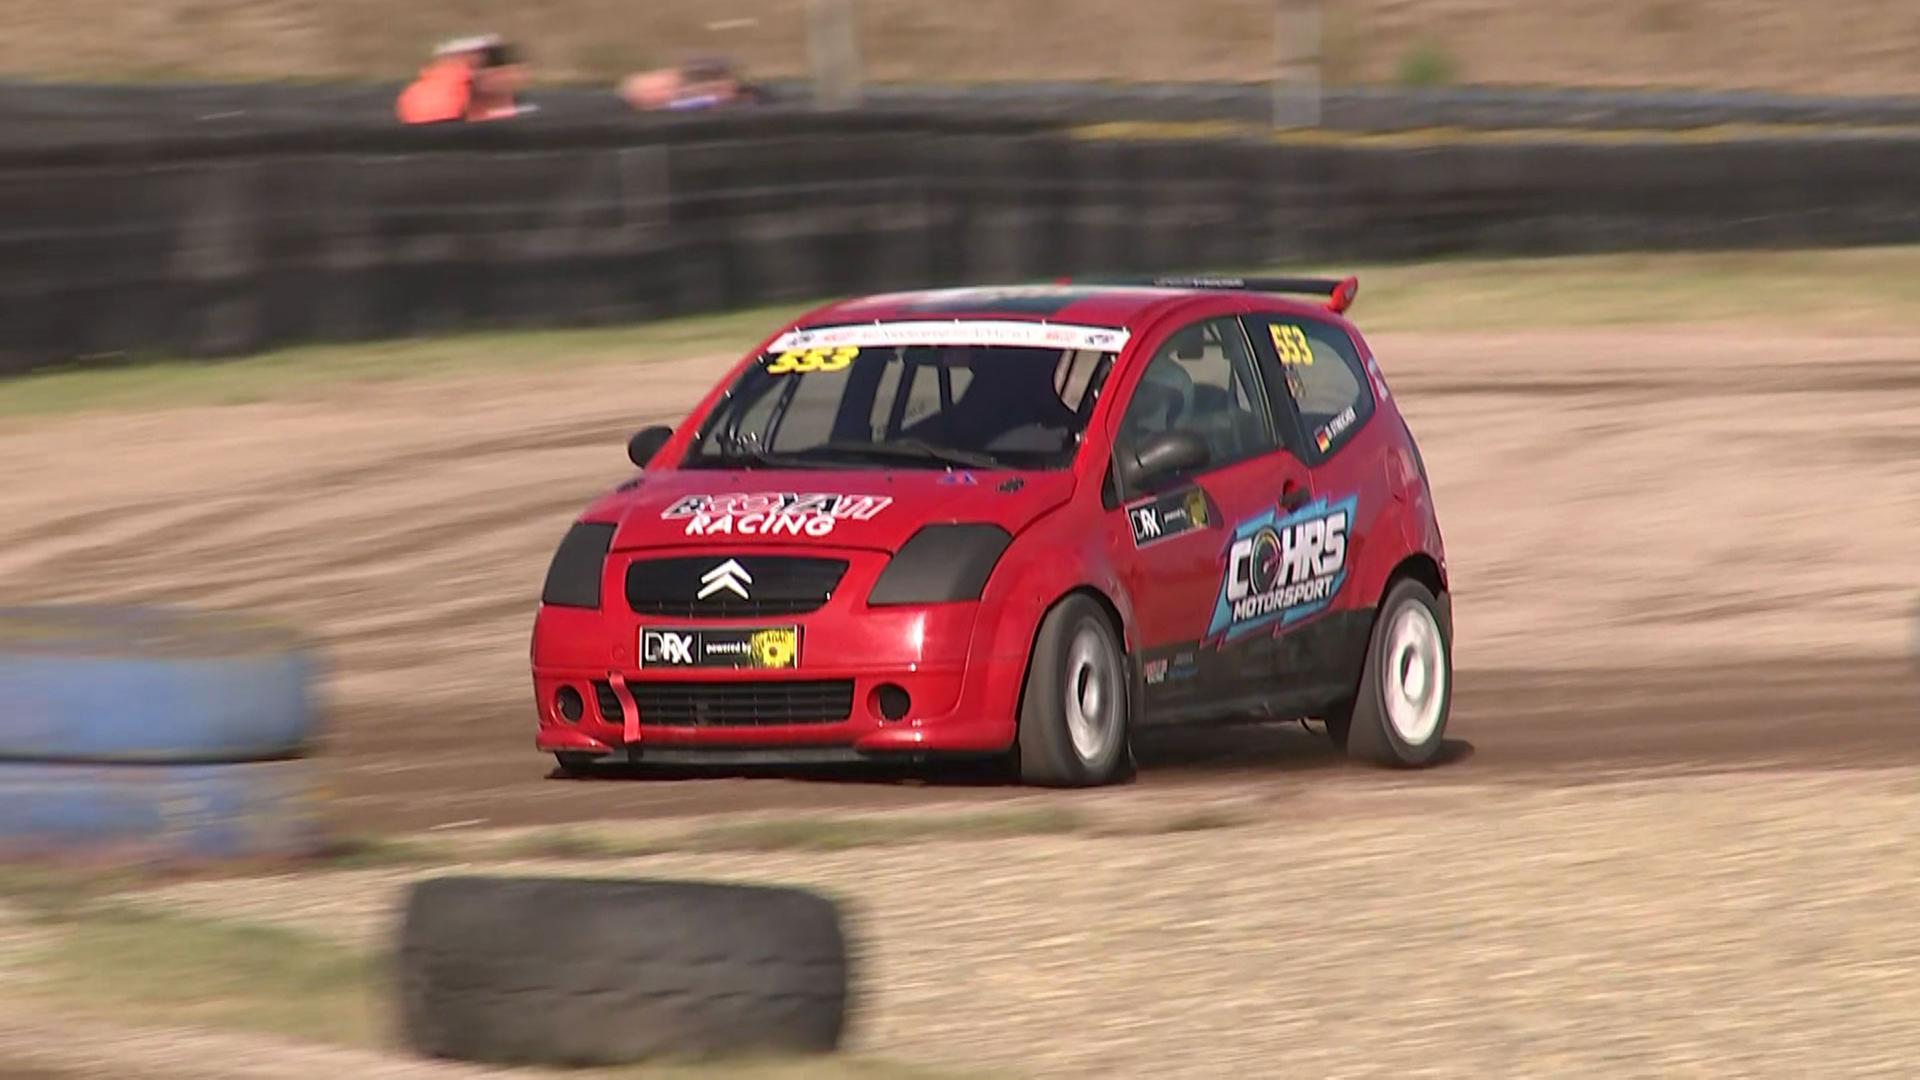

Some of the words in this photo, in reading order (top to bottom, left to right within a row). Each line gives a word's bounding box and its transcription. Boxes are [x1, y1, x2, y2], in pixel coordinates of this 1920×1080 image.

[1269, 324, 1314, 366] 553
[685, 512, 837, 537] RACING
[1227, 512, 1347, 602] COHRS
[1233, 575, 1334, 622] MOTORSPORT
[706, 641, 740, 656] powered
